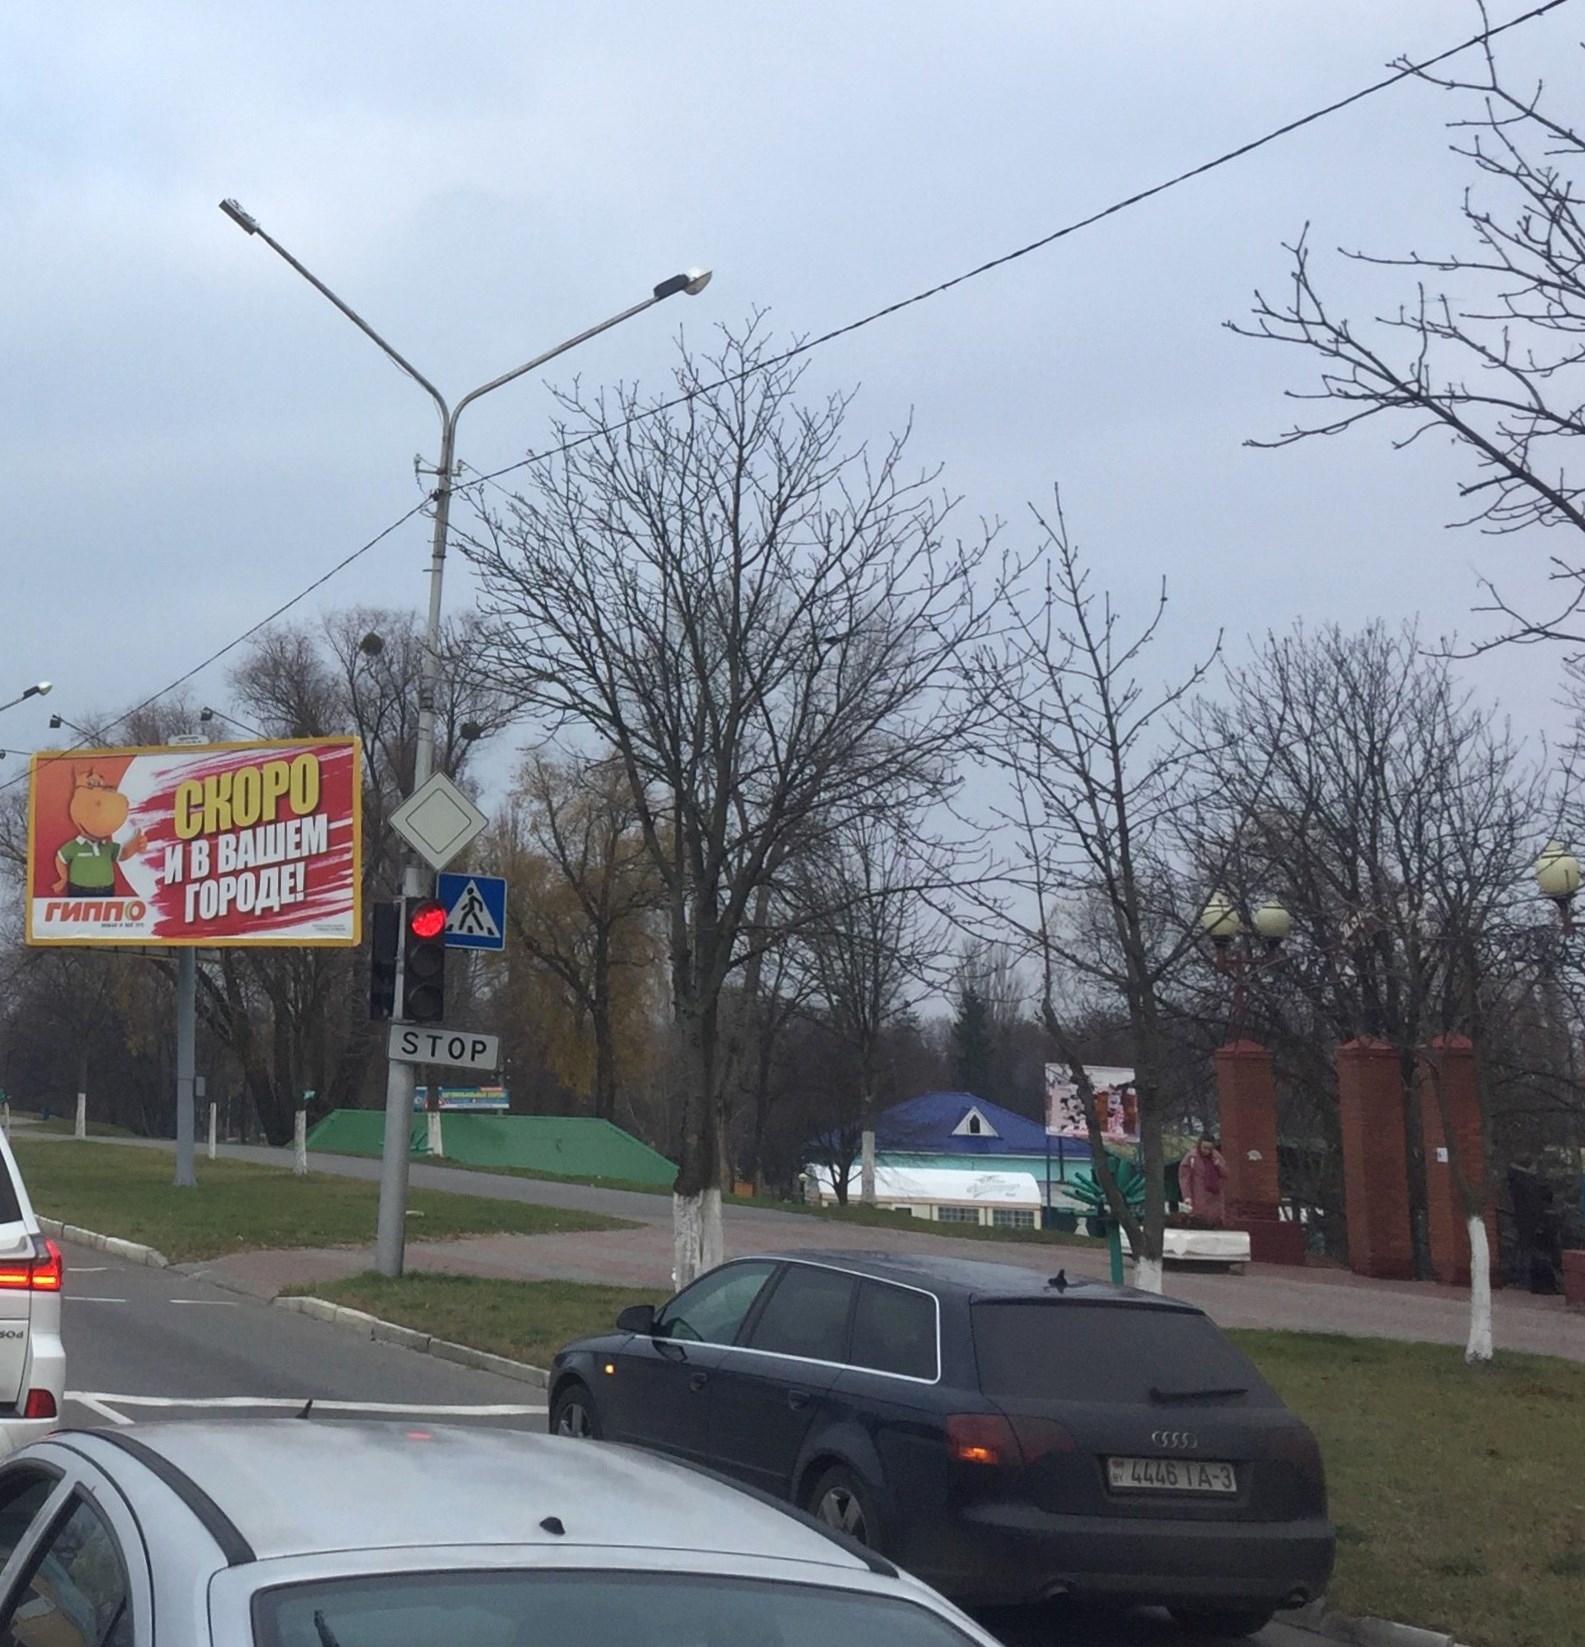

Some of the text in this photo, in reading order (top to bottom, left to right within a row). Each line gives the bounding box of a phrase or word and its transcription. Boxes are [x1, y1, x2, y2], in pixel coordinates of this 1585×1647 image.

[175, 753, 319, 840] СКОРО
[164, 813, 328, 885] И В ВАШЕМ
[45, 900, 146, 922] ГИППО
[185, 862, 305, 923] ГОРОДЕ!
[401, 1031, 487, 1062] STOP
[1132, 1460, 1178, 1486] 4446
